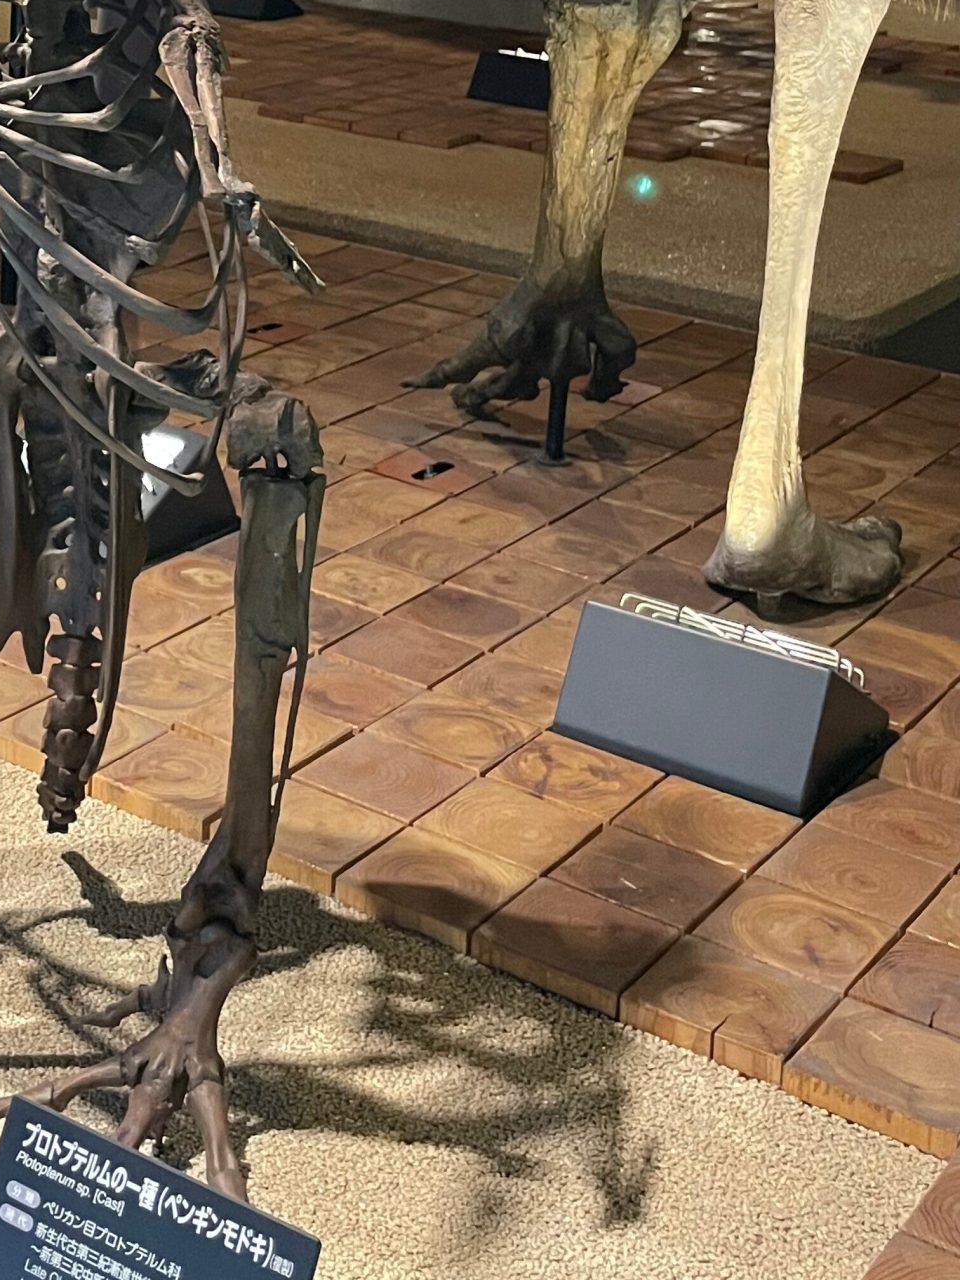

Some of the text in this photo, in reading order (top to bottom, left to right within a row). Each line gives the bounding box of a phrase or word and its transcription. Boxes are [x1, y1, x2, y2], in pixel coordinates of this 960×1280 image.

[15, 1150, 125, 1217] Plotopterum sp. [Cast]
[24, 1258, 48, 1280] Late
[43, 1201, 182, 1280] ペリカン目プロトプテルム科
